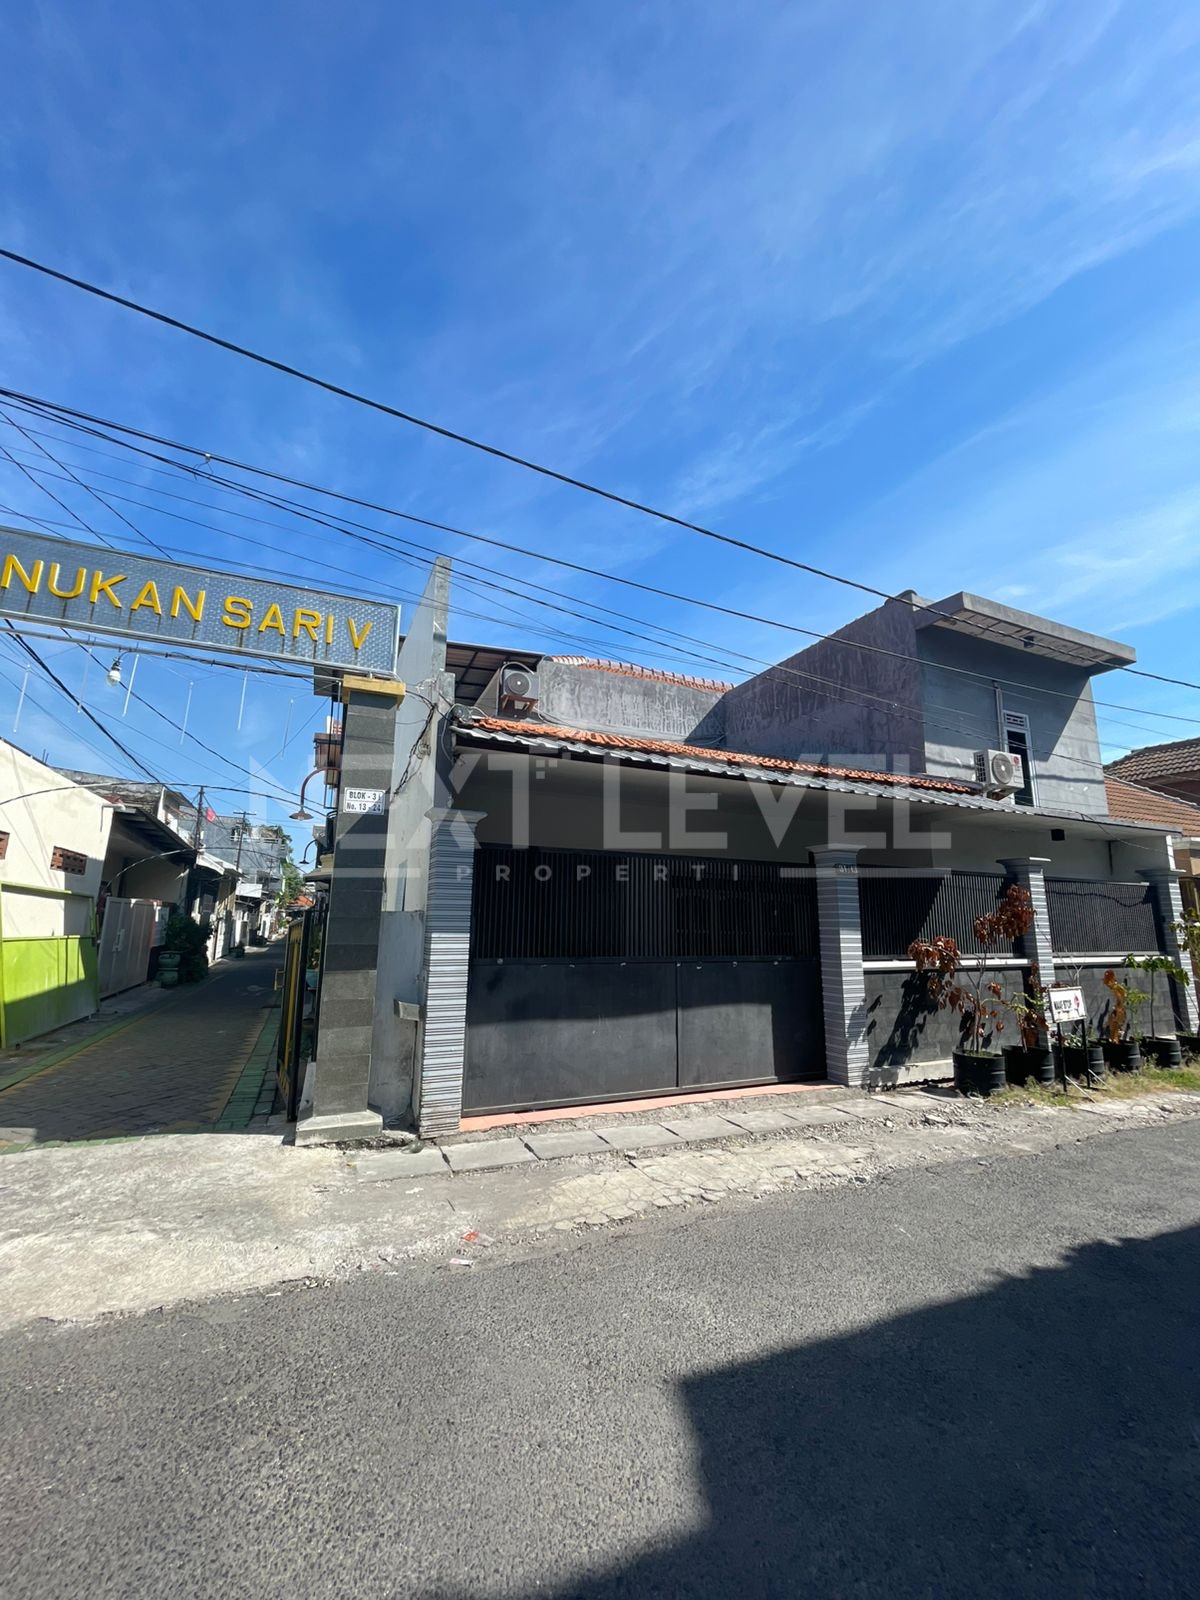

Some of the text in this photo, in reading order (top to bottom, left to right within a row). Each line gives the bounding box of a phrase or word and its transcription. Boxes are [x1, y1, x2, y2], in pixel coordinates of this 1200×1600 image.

[0, 554, 373, 649] NUKAN SARI V
[349, 791, 366, 799] BLOK
[346, 802, 357, 811] No.
[358, 803, 367, 811] 13
[372, 804, 381, 812] 24
